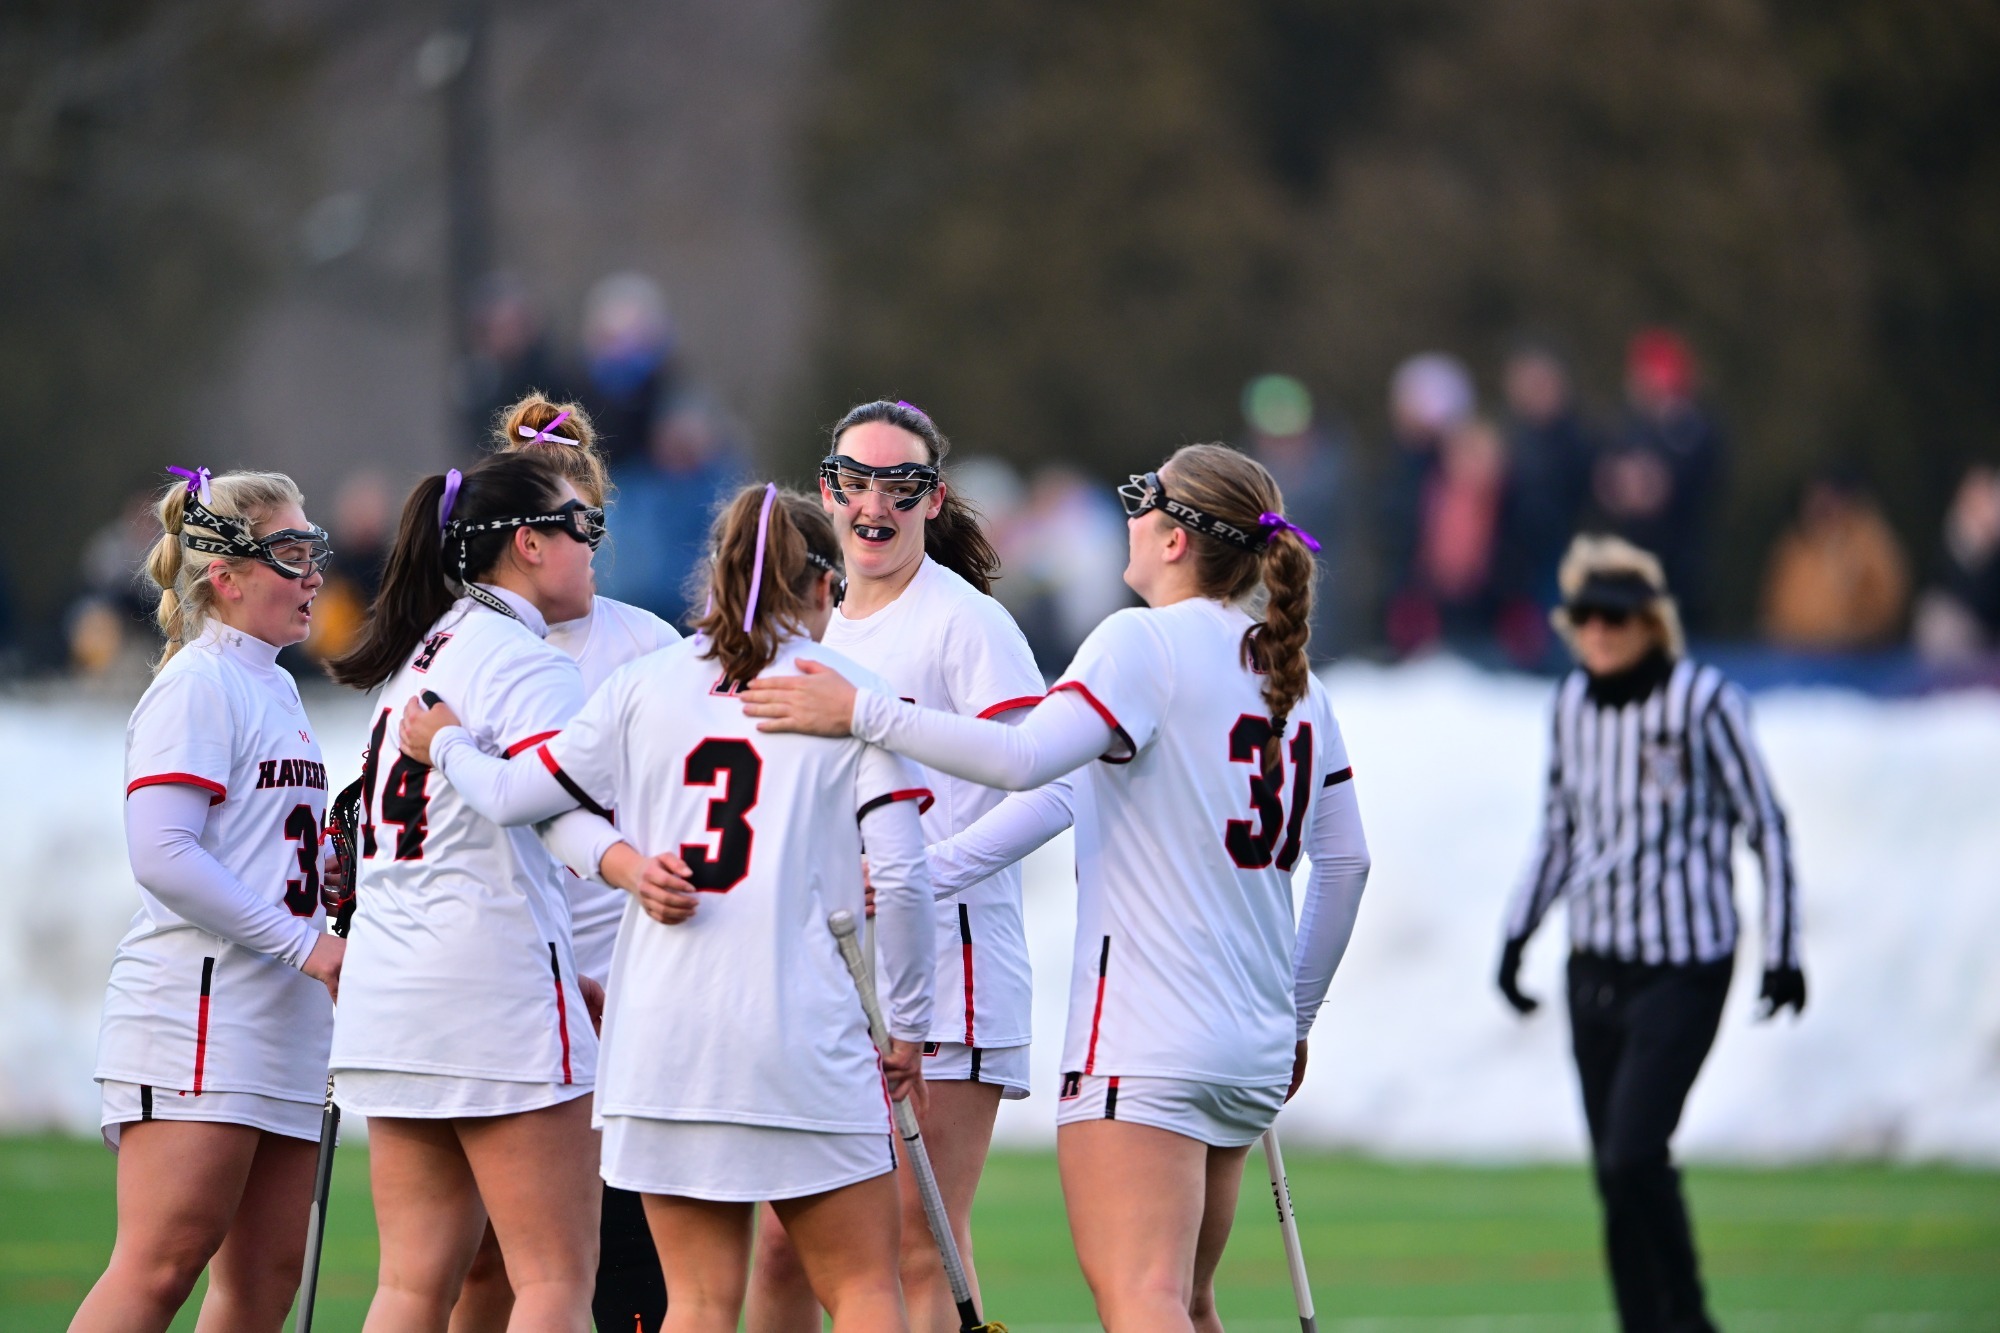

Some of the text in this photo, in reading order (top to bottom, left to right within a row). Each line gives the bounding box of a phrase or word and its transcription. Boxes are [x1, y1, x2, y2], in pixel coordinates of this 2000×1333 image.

[193, 506, 224, 532] STX
[1165, 500, 1203, 523] STX
[195, 538, 234, 554] STX
[232, 529, 261, 552] ST
[1212, 520, 1249, 544] STX
[256, 758, 329, 792] HAVERF
[361, 707, 431, 861] 14
[1225, 713, 1313, 872] 31
[680, 737, 763, 893] 3
[284, 803, 327, 918] 3
